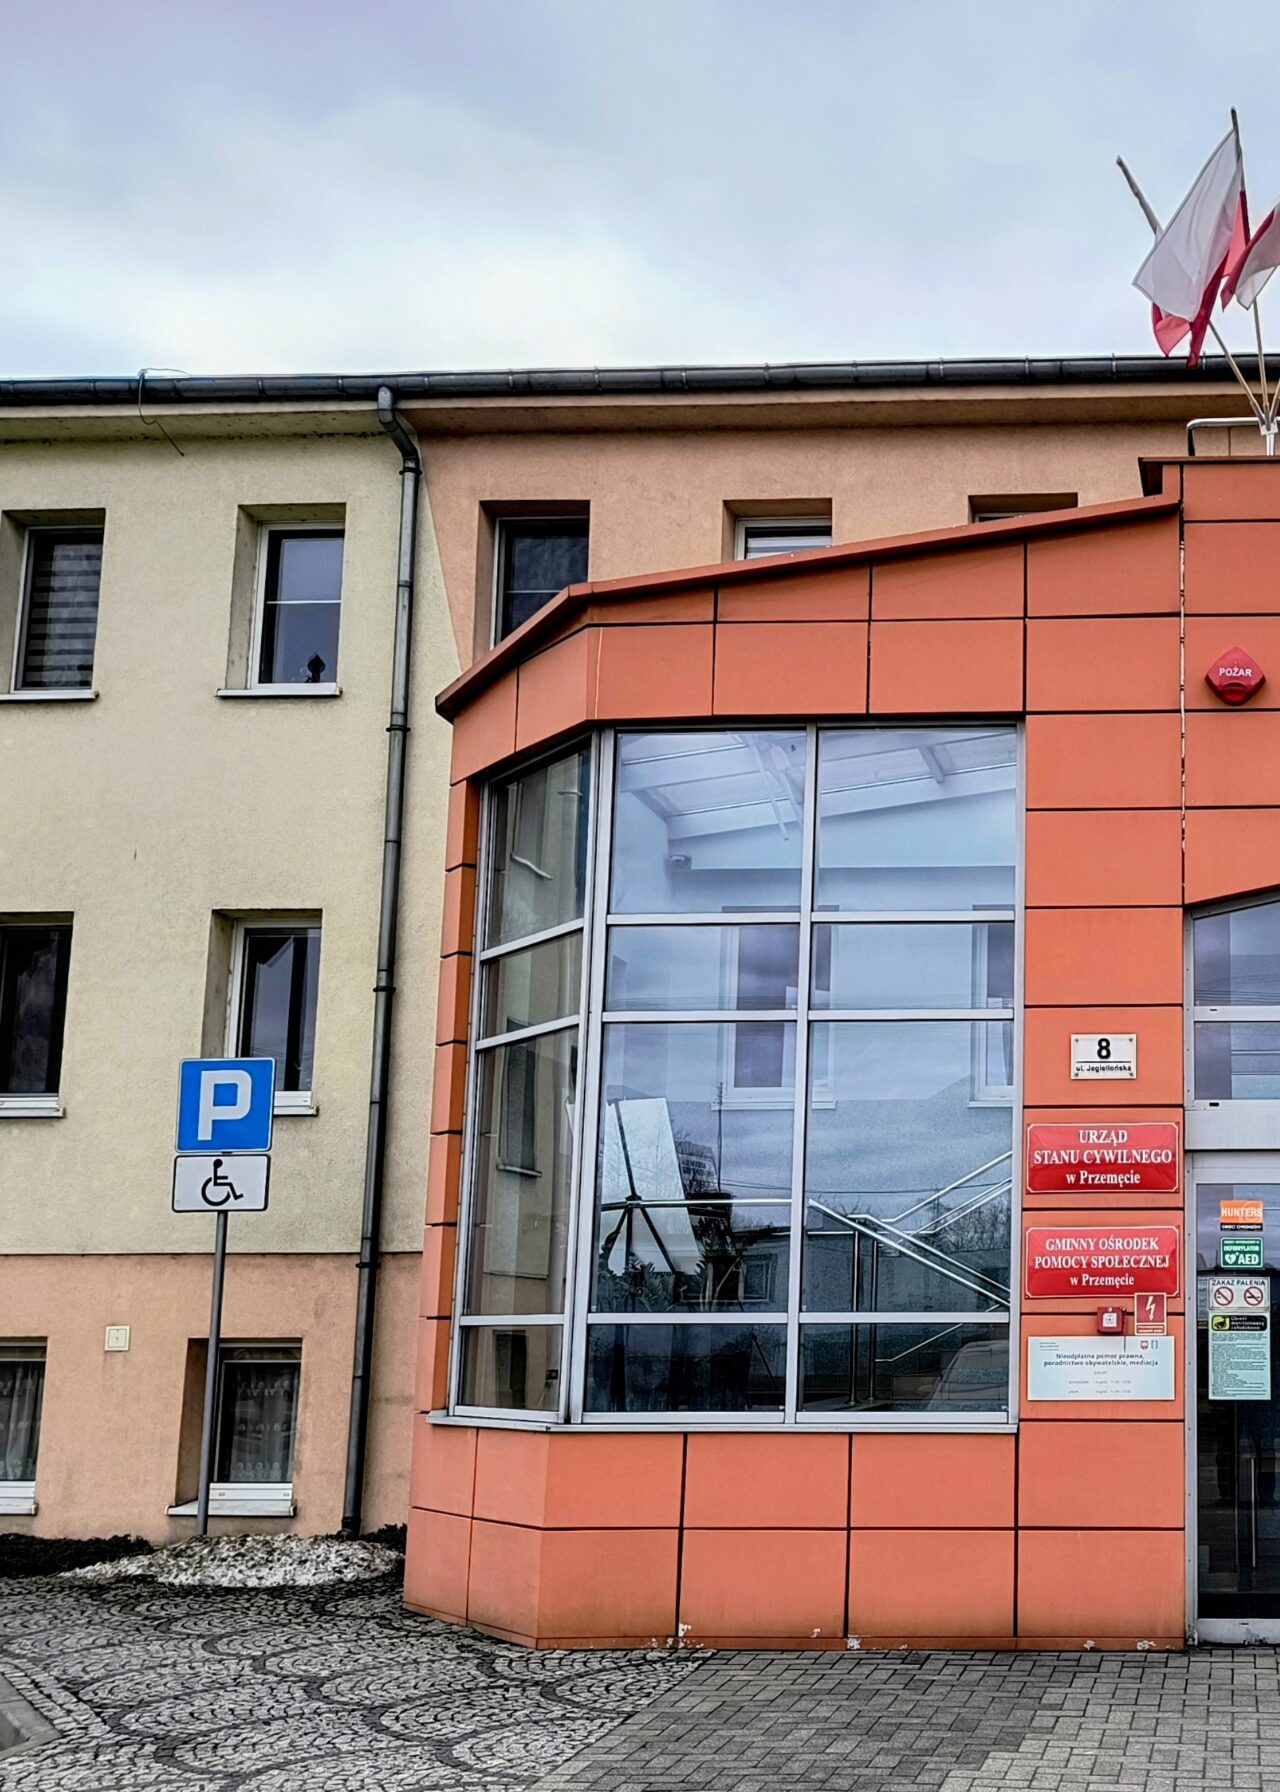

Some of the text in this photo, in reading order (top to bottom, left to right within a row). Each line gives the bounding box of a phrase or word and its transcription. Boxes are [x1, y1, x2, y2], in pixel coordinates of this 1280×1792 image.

[1218, 666, 1253, 677] POŻAR
[1096, 1037, 1112, 1060] 8
[1086, 1064, 1132, 1073] Jagiellońska
[197, 1069, 253, 1141] P
[1079, 1129, 1128, 1146] URZĄD
[1033, 1149, 1173, 1164] STANU CYWILNEGO
[1066, 1169, 1141, 1188] w Przemęcie
[1221, 1207, 1263, 1217] HUNTERS
[1045, 1235, 1159, 1251] GMINNY OŚRODEK
[1034, 1254, 1171, 1269] POMOCY SPOŁECZNEJ
[1237, 1253, 1260, 1265] AED
[1070, 1273, 1135, 1288] w Przemęcie
[1129, 1359, 1159, 1367] mediacja
